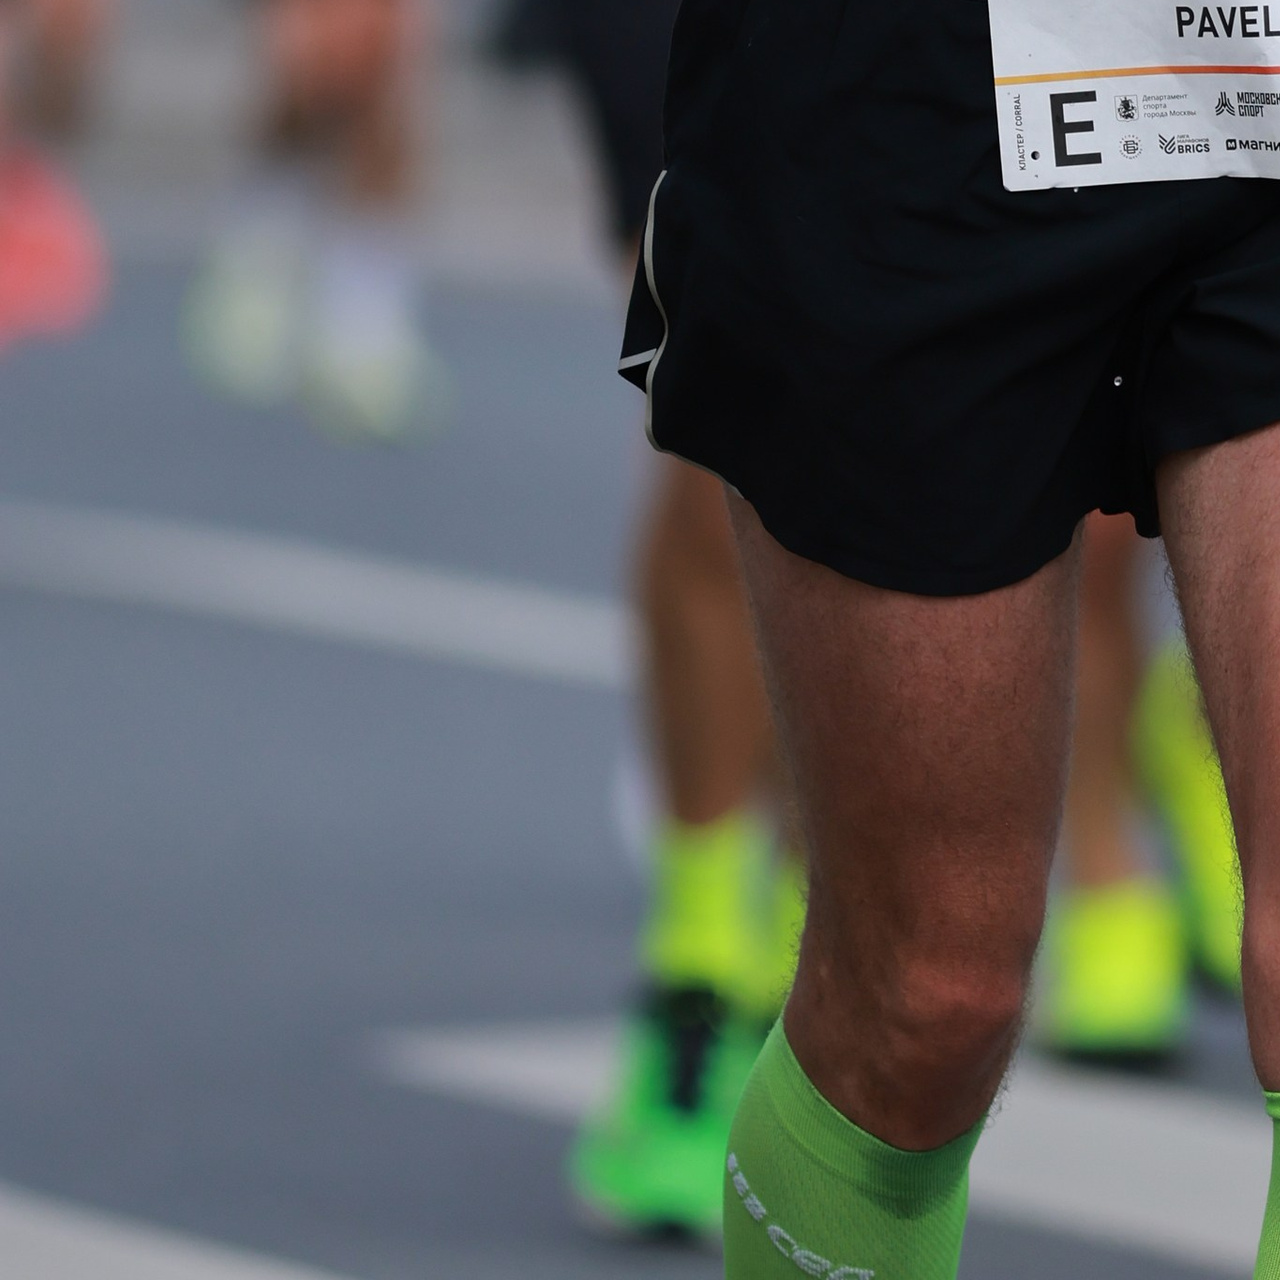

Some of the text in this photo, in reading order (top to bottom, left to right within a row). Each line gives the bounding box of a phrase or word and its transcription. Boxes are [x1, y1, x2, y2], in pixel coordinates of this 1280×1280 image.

[1142, 94, 1188, 102] Департамент
[1013, 94, 1023, 127] CORRAL
[1238, 105, 1264, 117] СПОРТ
[1050, 90, 1102, 167] E
[1016, 133, 1027, 171] КЛАСТЕР
[1178, 143, 1210, 154] BRICS
